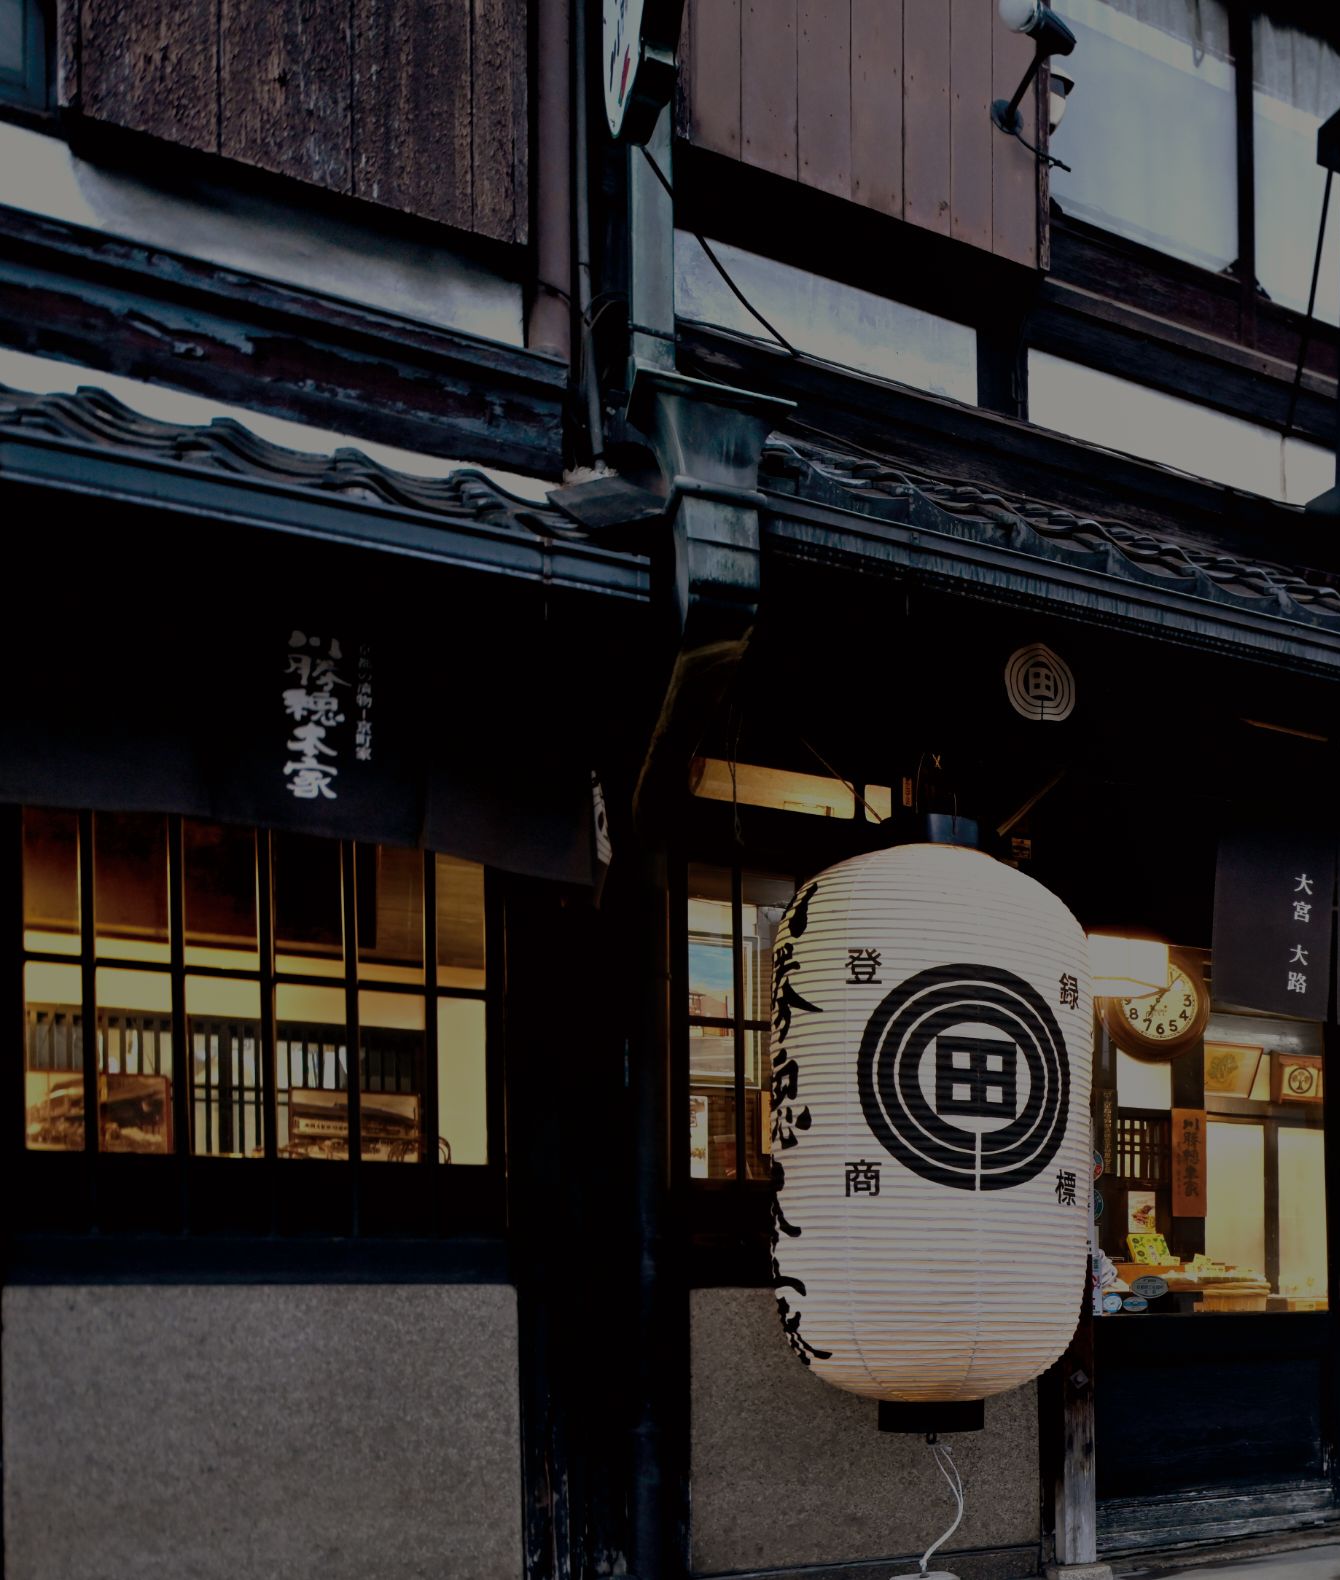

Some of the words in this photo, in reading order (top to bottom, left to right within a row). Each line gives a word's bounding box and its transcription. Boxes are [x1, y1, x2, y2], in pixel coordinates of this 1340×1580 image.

[1293, 874, 1313, 922] 大宮
[846, 949, 881, 984] 登
[1287, 945, 1308, 993] 大路
[1129, 1008, 1138, 1020] 8
[1179, 1009, 1189, 1021] 4
[1156, 1024, 1165, 1035] 6
[1169, 1020, 1178, 1032] 5
